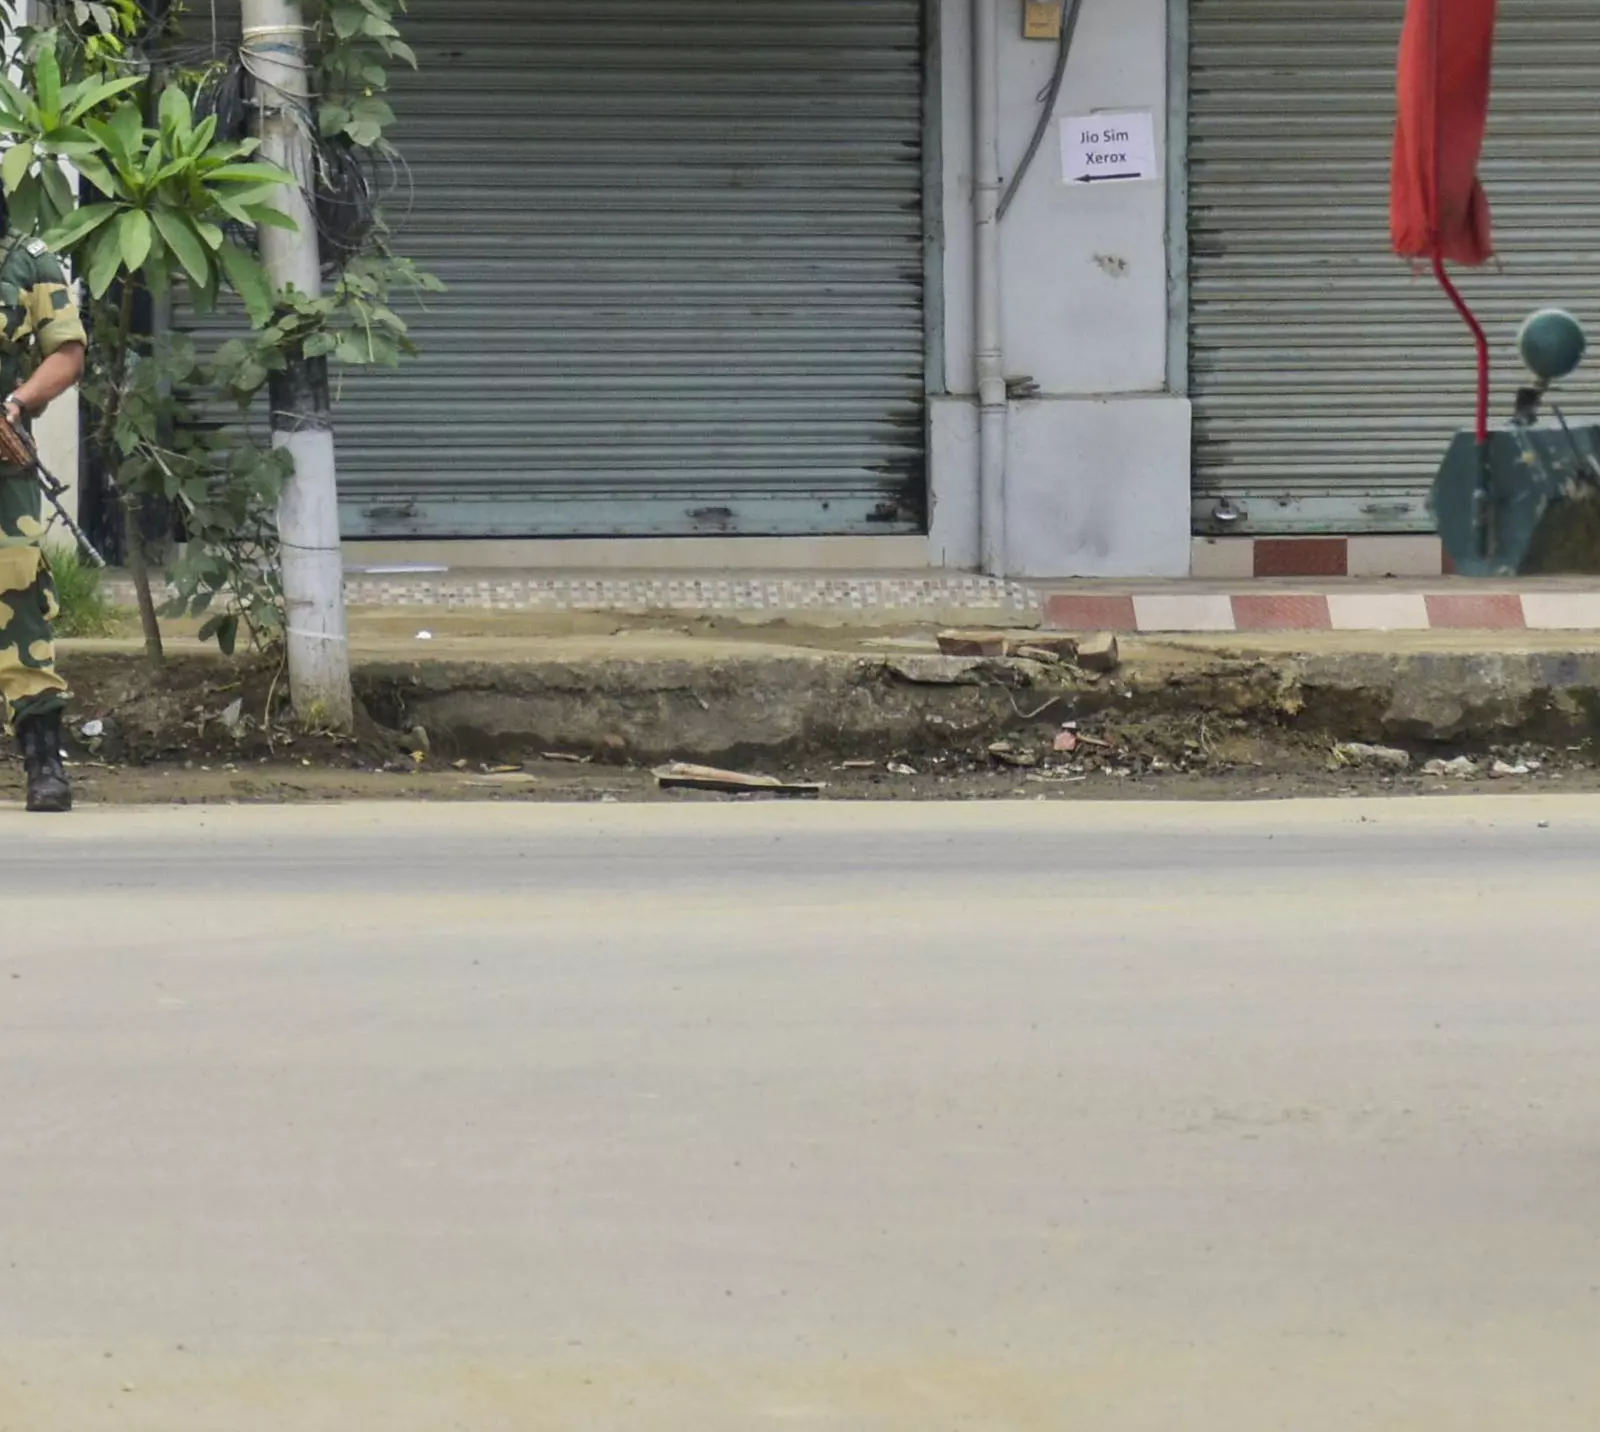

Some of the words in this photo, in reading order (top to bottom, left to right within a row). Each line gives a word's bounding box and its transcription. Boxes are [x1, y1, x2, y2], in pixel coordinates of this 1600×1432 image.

[1080, 130, 1100, 145] Jio
[1103, 128, 1129, 143] Sim
[1085, 151, 1127, 165] Xerox
